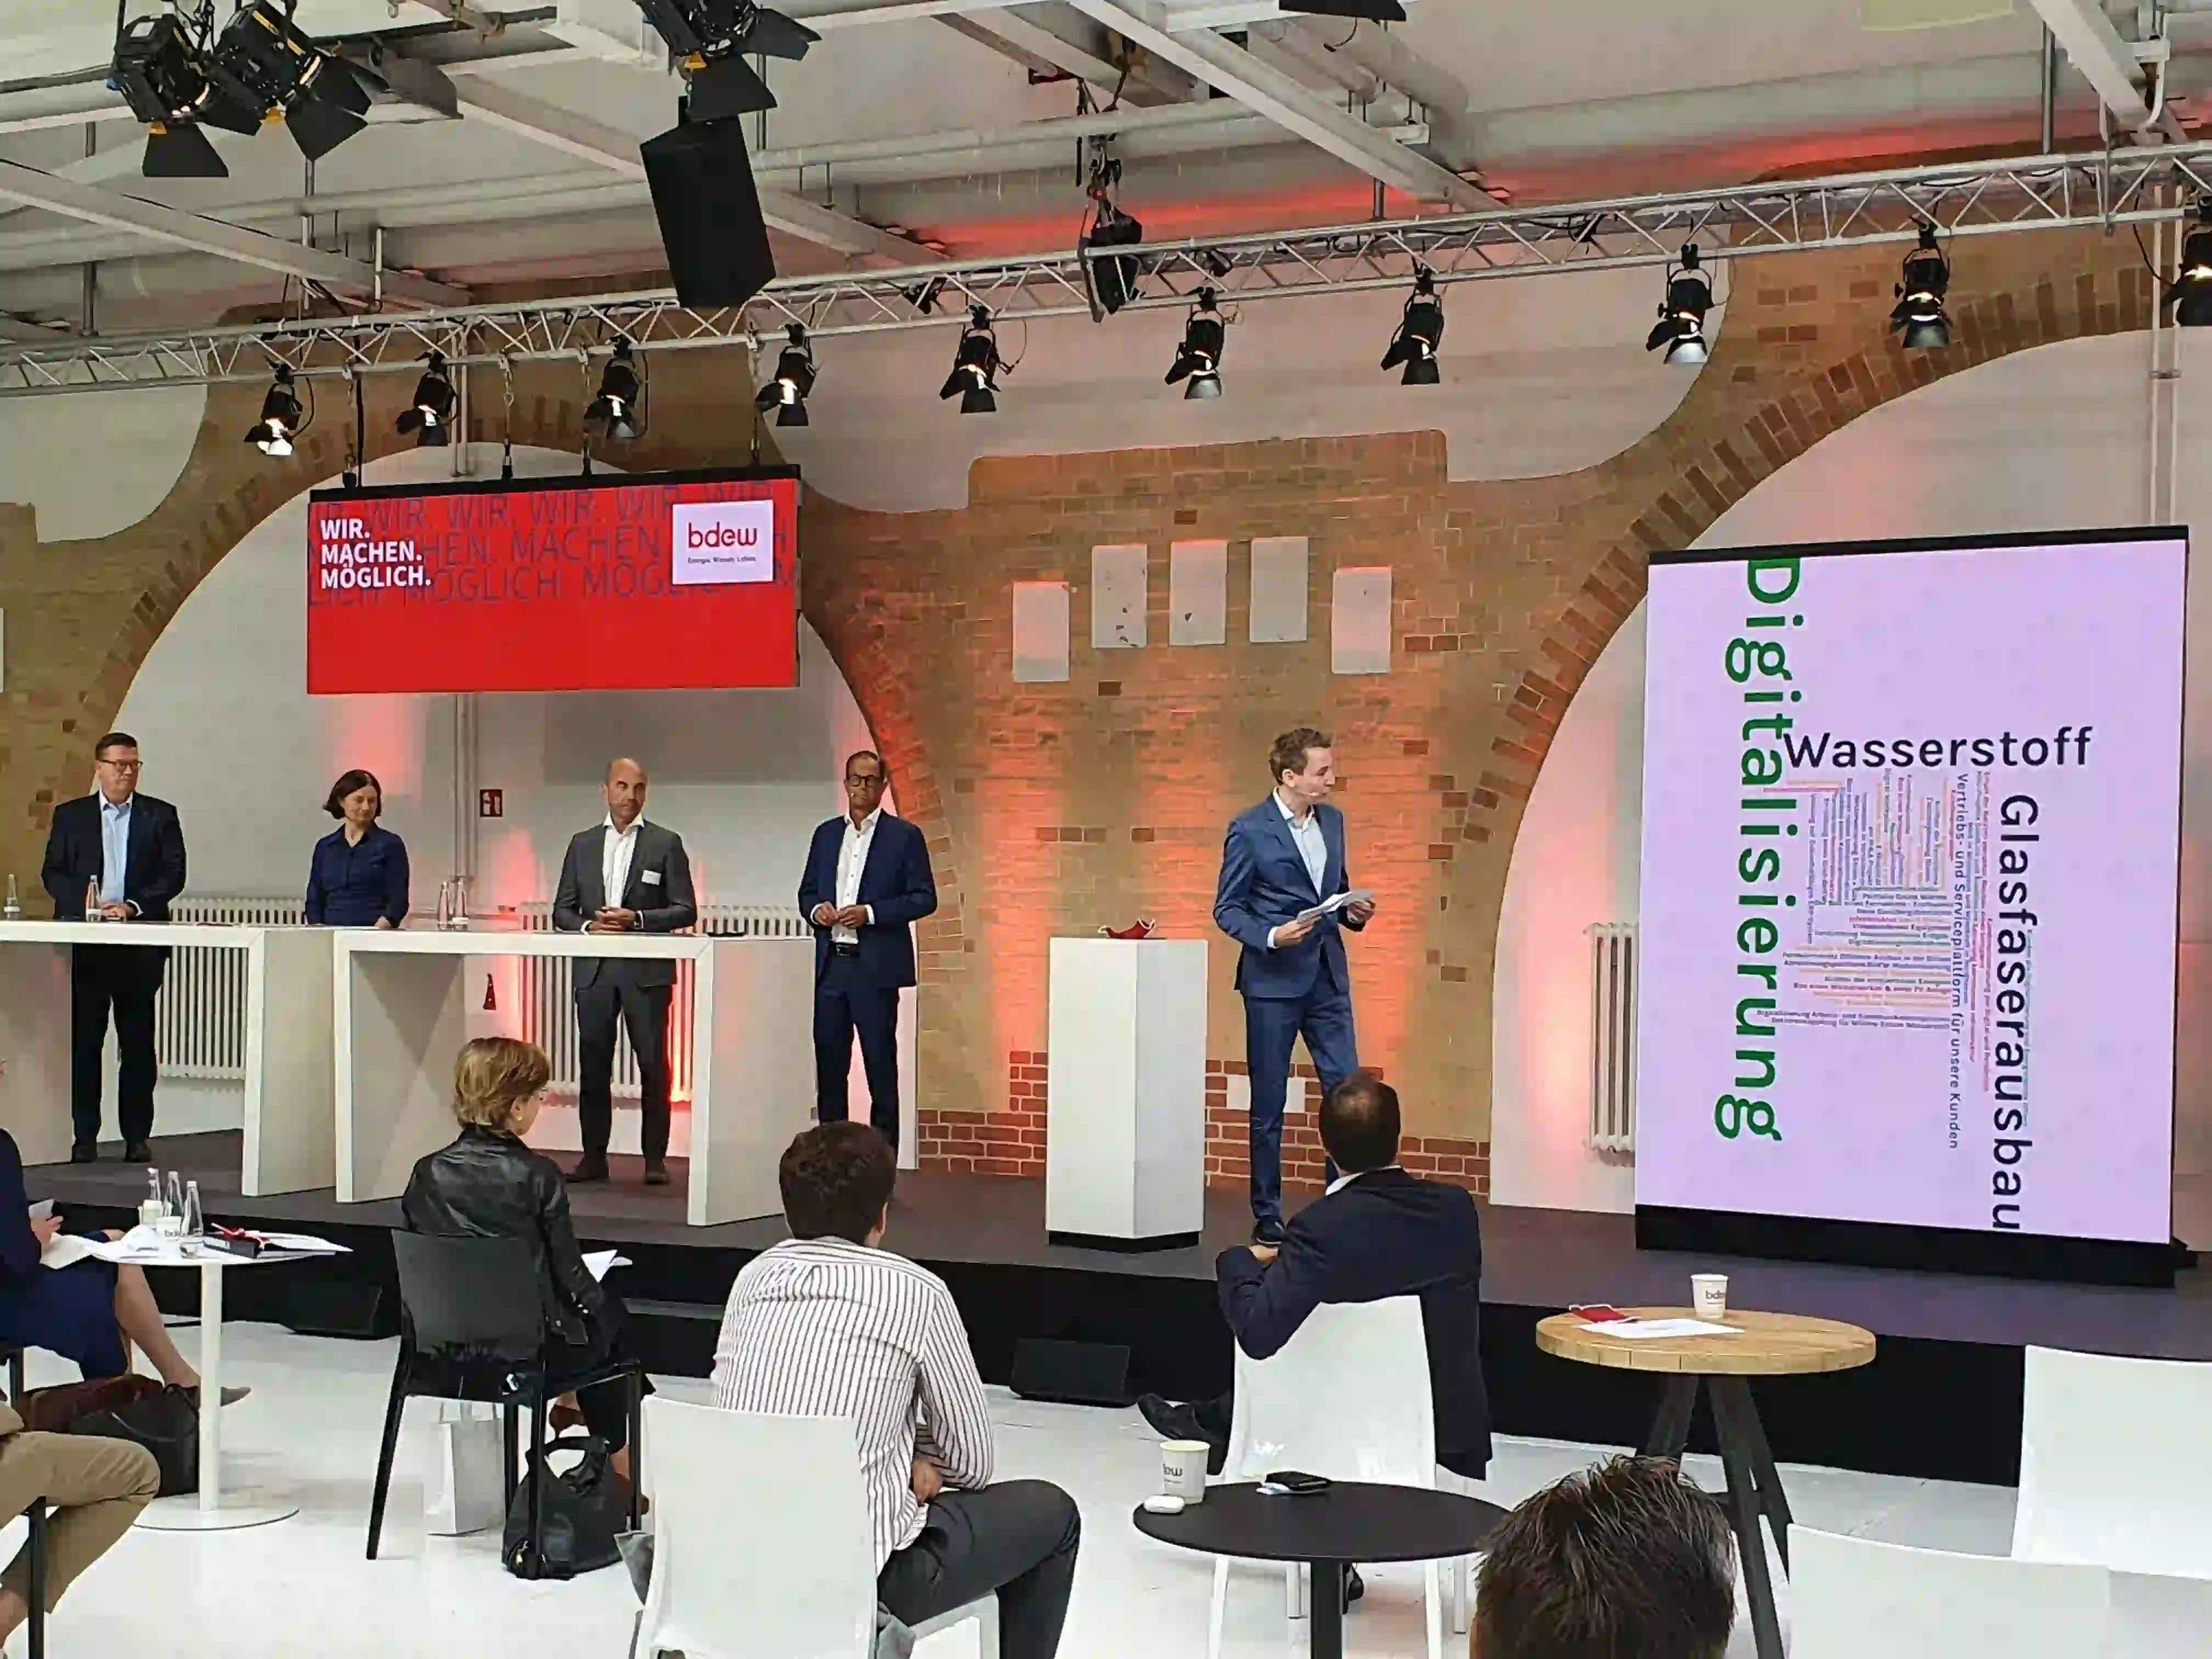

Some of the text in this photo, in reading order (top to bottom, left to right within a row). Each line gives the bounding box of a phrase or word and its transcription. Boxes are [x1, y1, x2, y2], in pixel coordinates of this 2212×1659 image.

[320, 518, 371, 540] WIR.
[689, 521, 758, 549] bdew
[321, 540, 422, 565] MACHEN.
[321, 561, 432, 589] MÖGLICH.
[1783, 725, 2093, 768] Wasserstoff
[1714, 557, 1804, 1141] Digitalisierung
[1955, 851, 1967, 878] und
[1951, 1013, 1965, 1034] für
[1992, 794, 2039, 1229] Glasfaserausbau
[1950, 1039, 1960, 1088] unsere
[1949, 1093, 1962, 1149] Kunden
